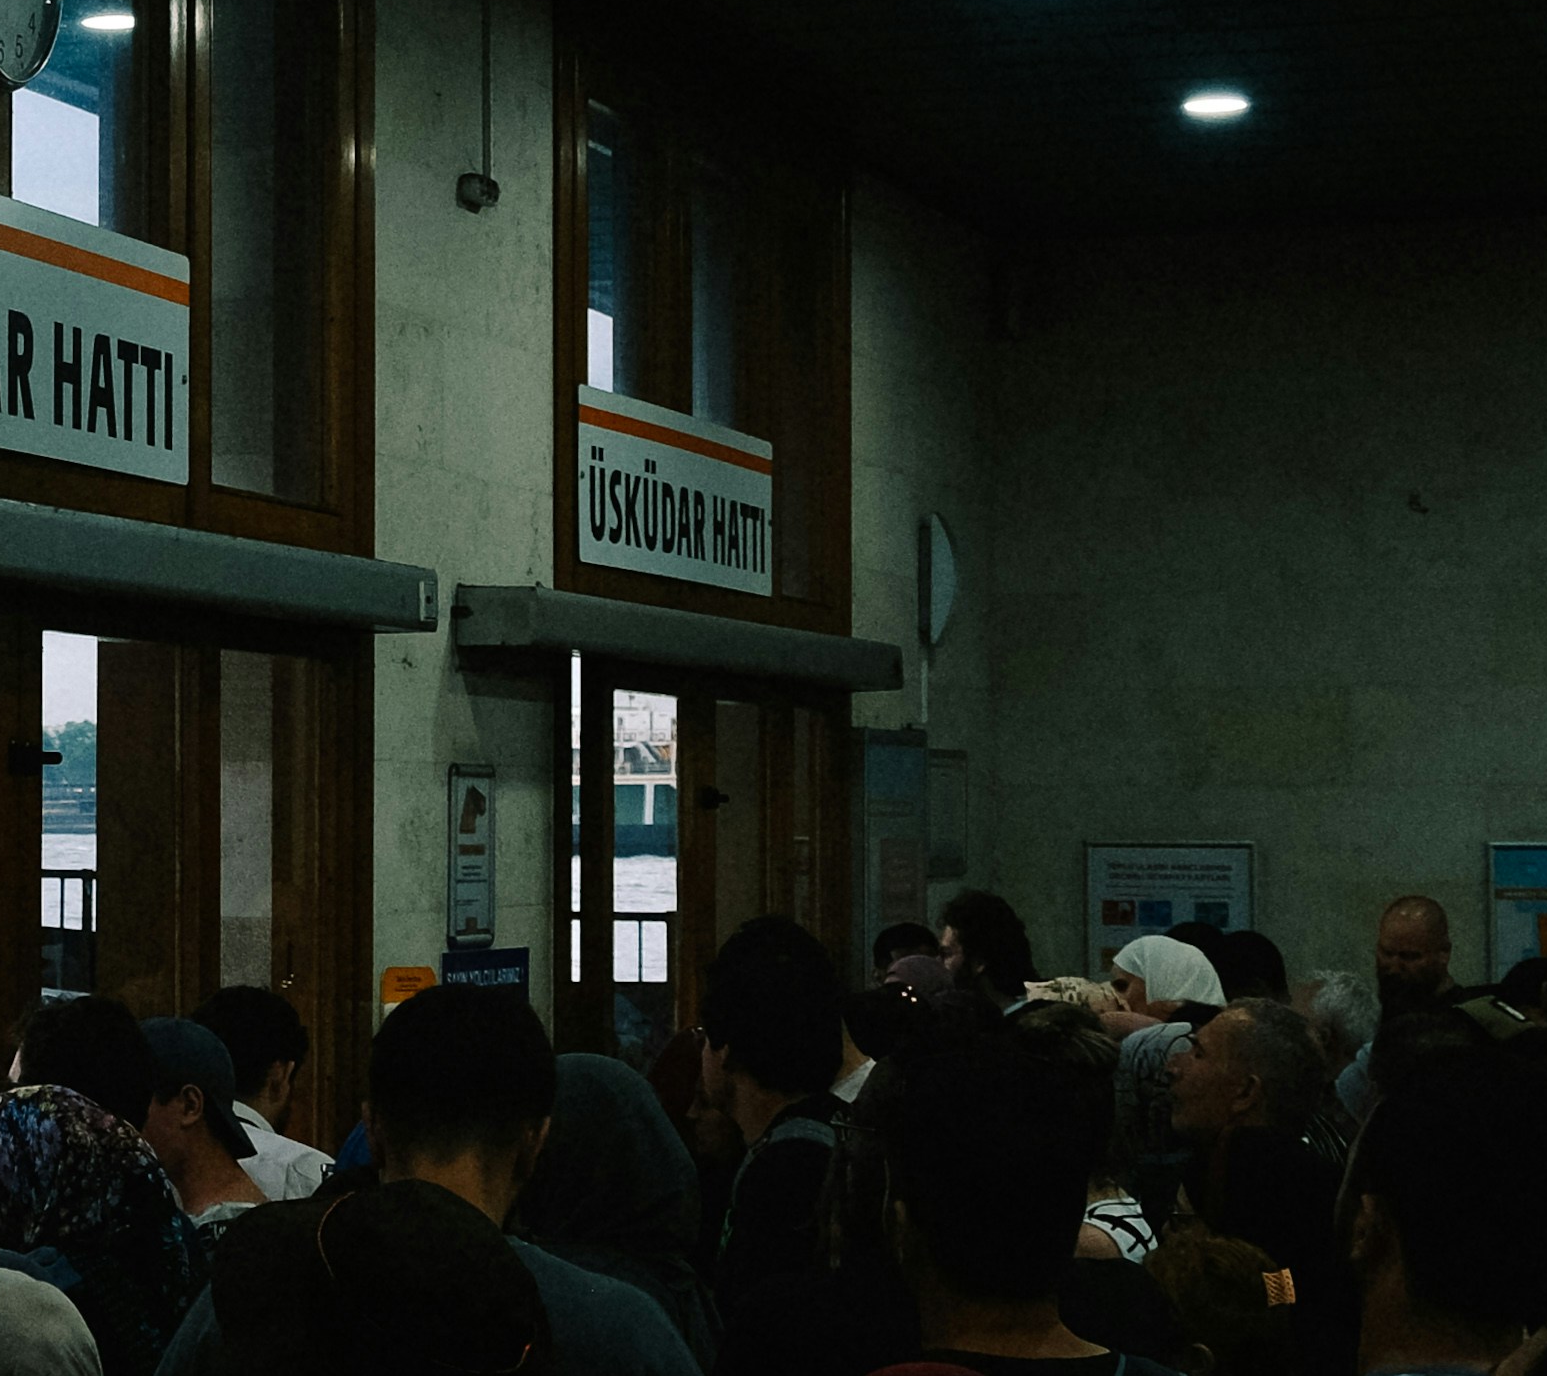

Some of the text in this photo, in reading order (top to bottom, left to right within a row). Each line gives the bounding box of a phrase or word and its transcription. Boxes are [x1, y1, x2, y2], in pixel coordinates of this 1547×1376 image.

[15, 34, 24, 58] 5
[28, 13, 36, 35] 4
[53, 321, 174, 451] HATTI
[589, 445, 765, 574] ÜSKÜDAR HATTI
